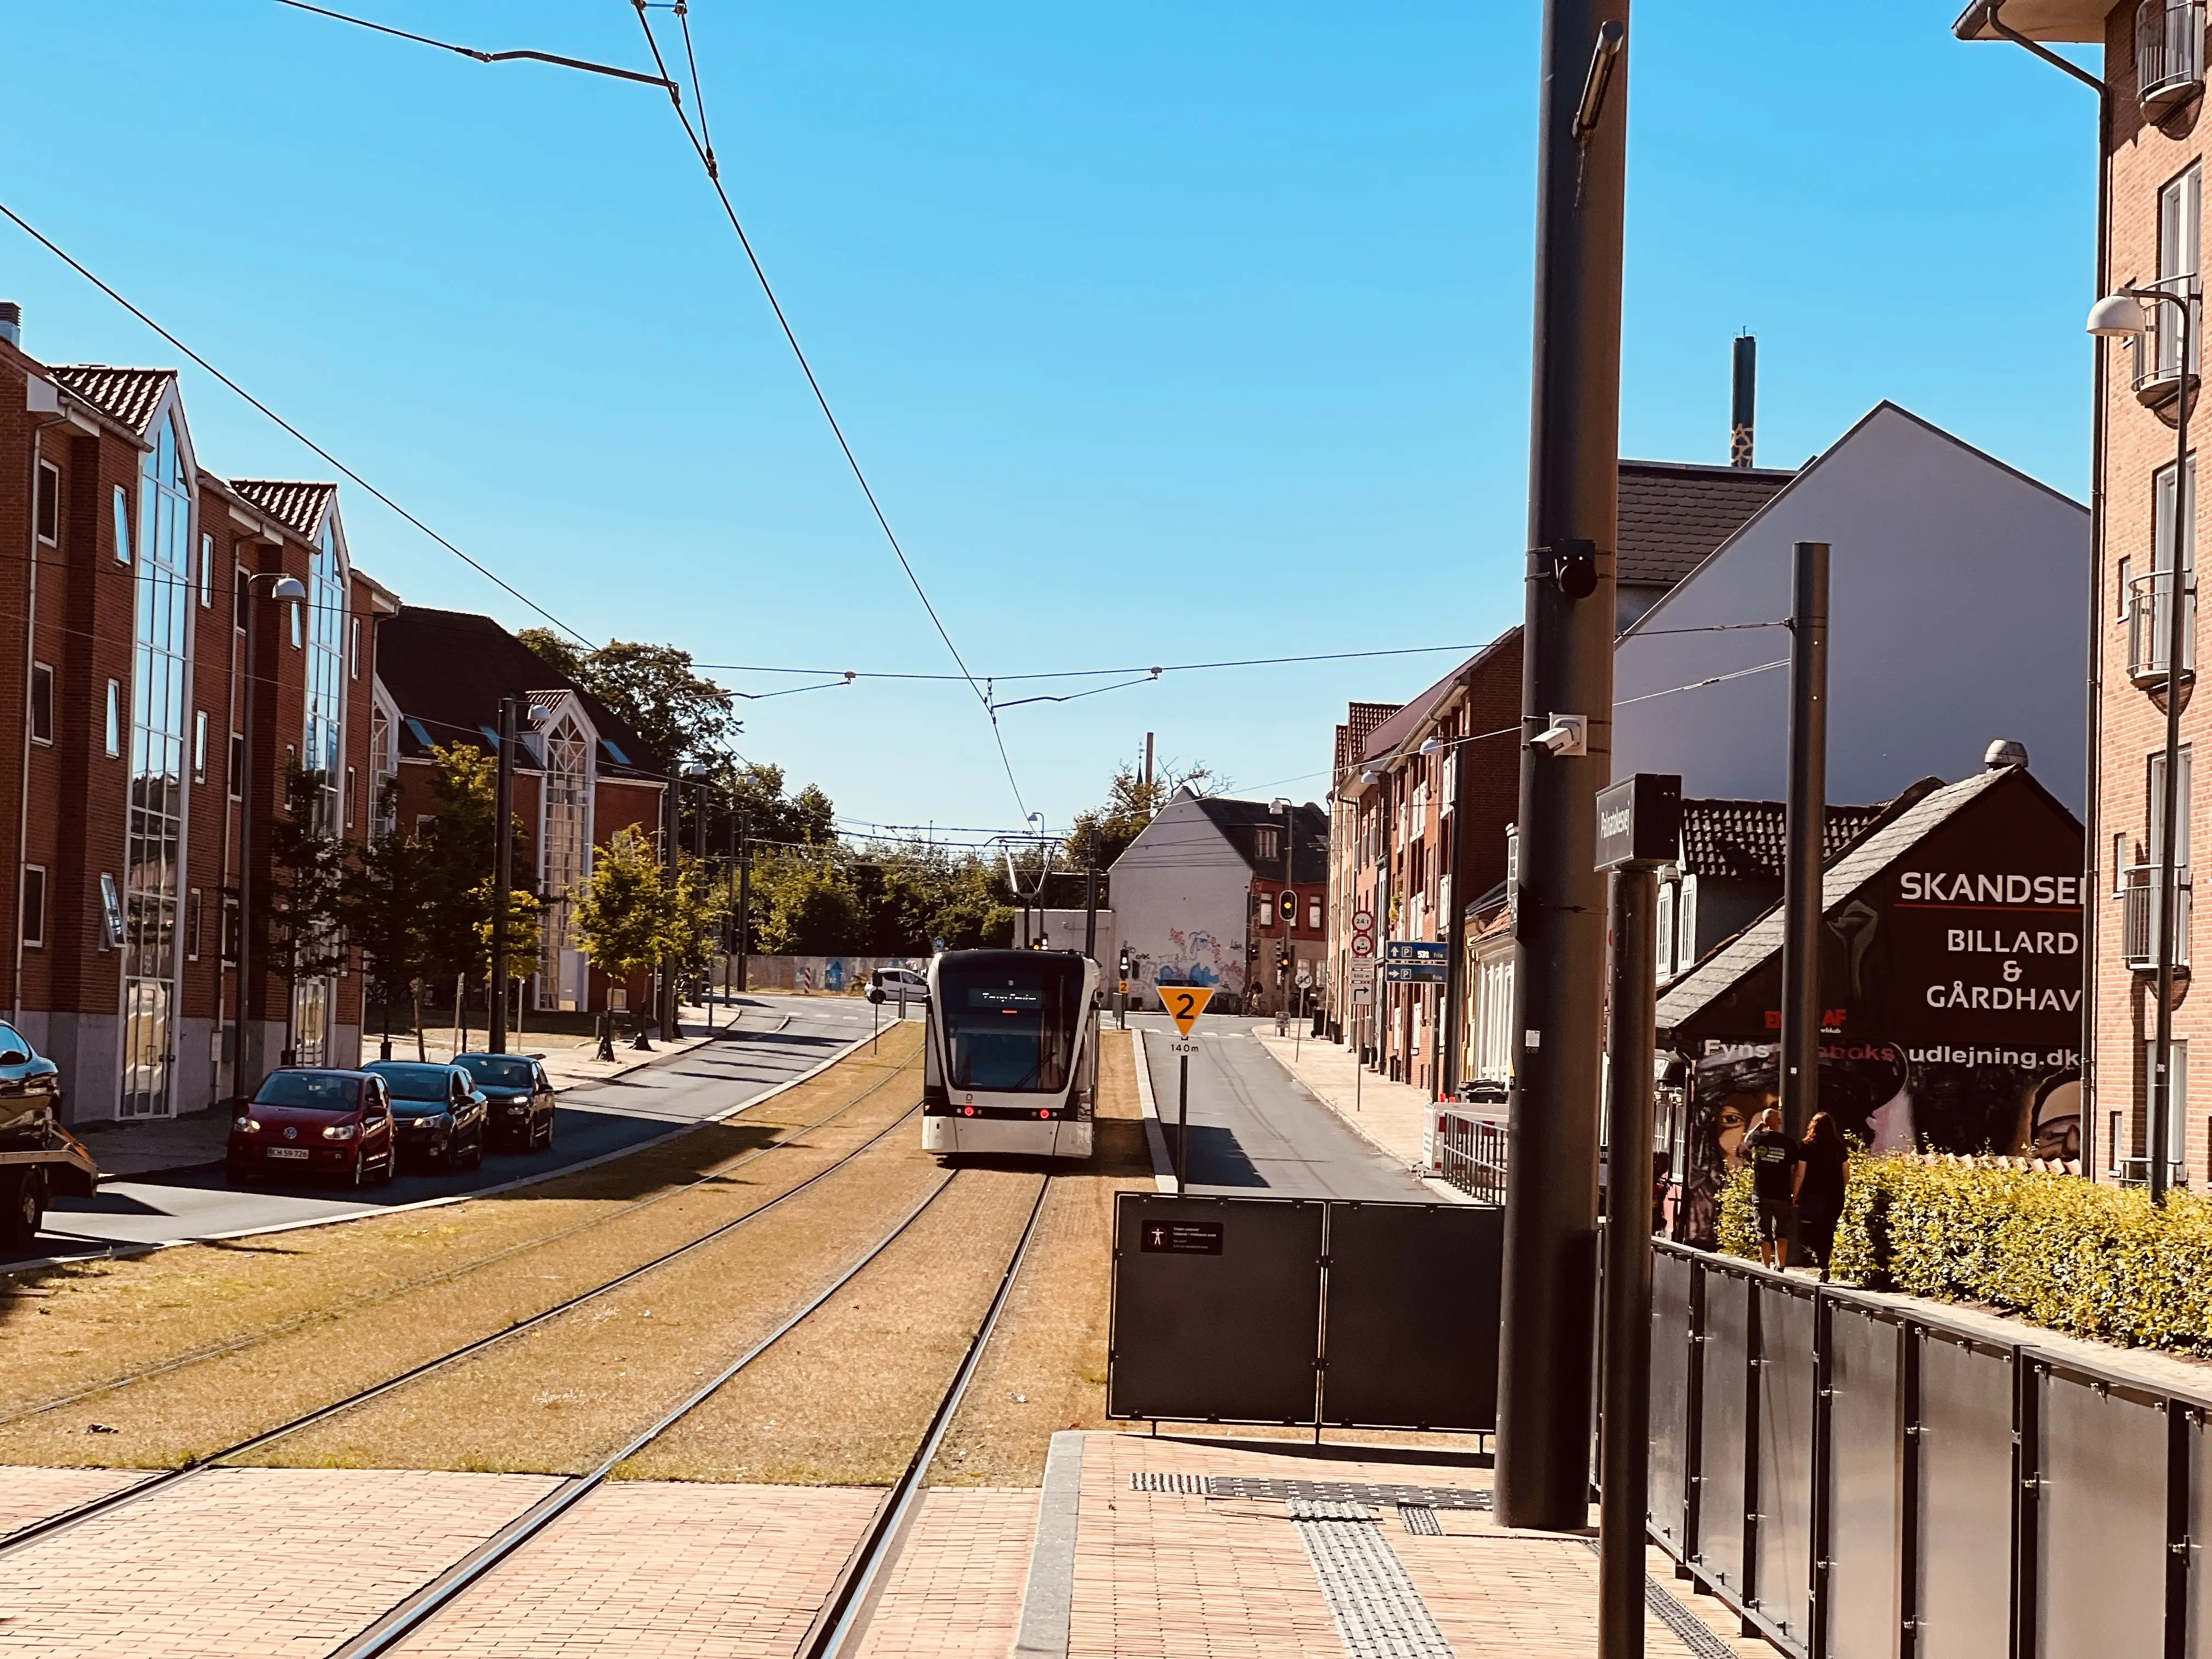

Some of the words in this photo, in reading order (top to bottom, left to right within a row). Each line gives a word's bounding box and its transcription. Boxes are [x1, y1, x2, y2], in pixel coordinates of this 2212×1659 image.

[1948, 929, 2078, 954] BILLARD
[2003, 960, 2022, 982] &
[1120, 983, 1127, 991] 2
[1927, 980, 2081, 1012] GÅRDHAV
[1176, 994, 1194, 1020] 2
[1171, 1044, 1199, 1052] 140m
[1704, 1040, 1770, 1060] Fyns
[1909, 1046, 2080, 1069] udlejning.dk
